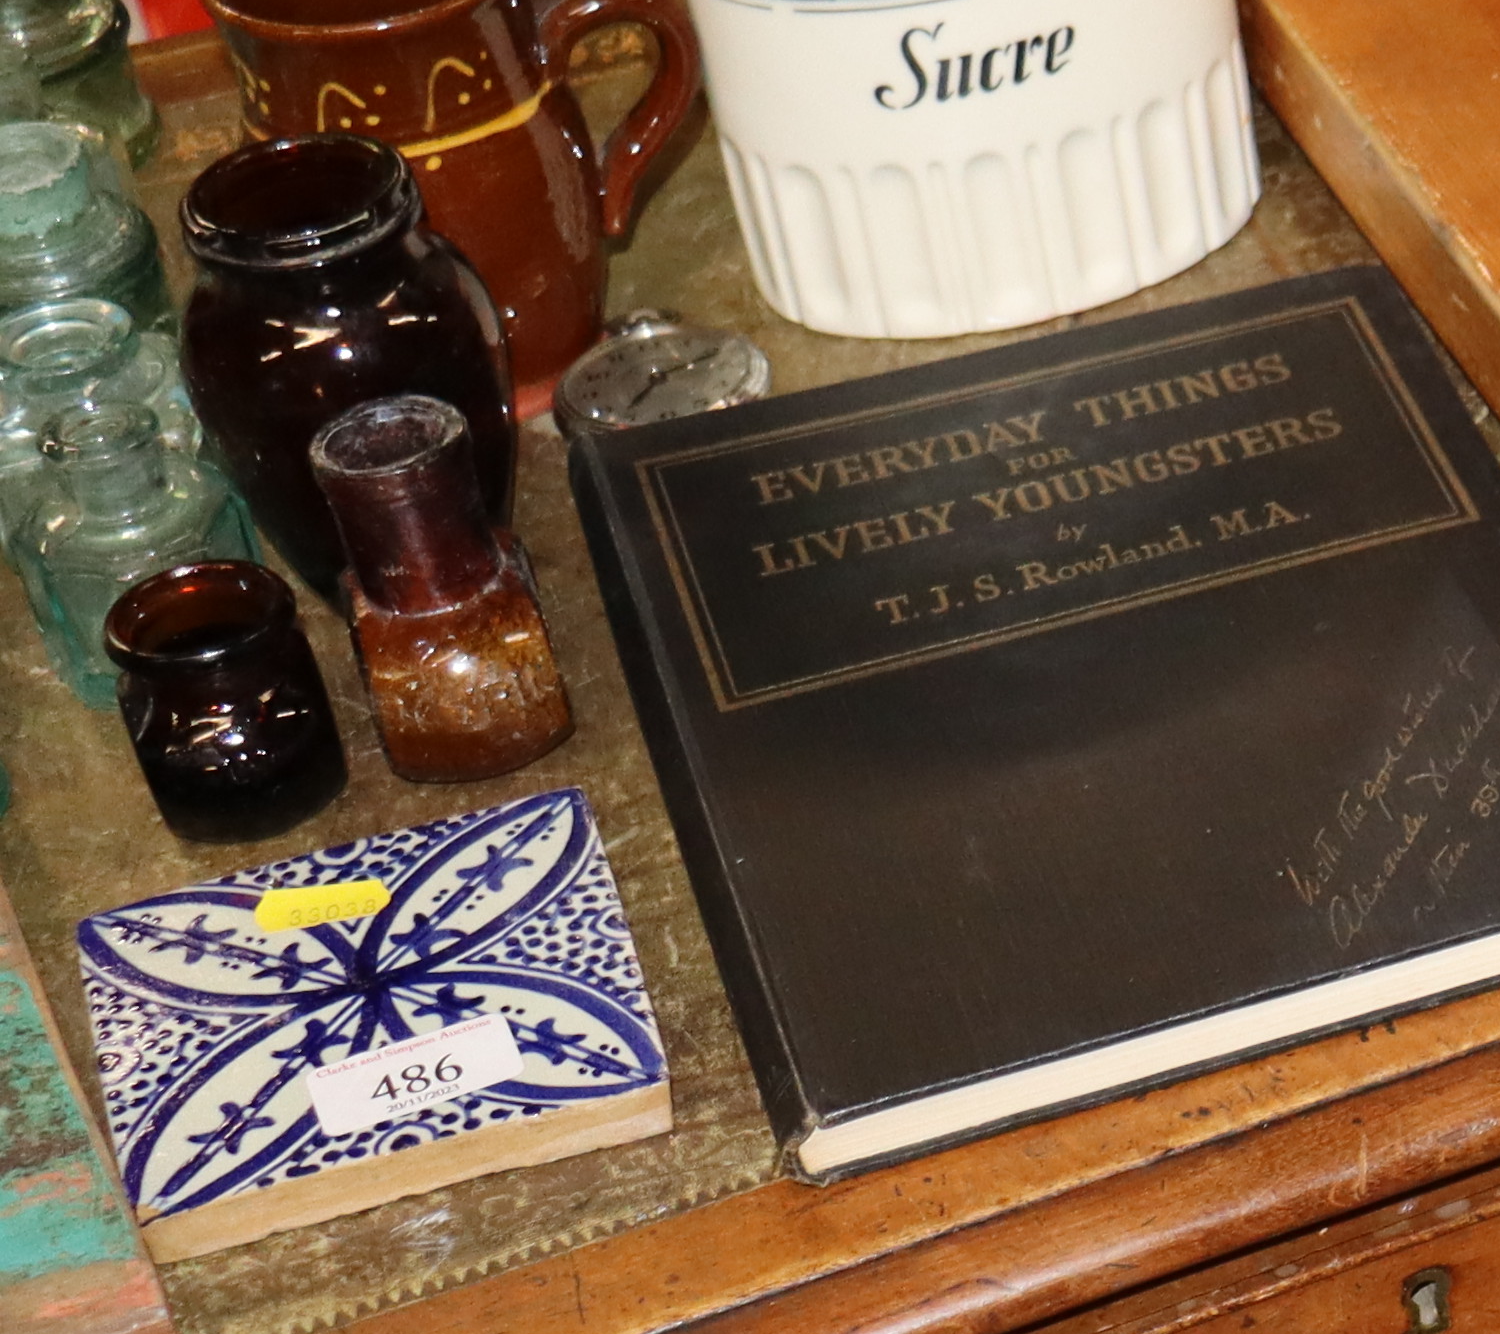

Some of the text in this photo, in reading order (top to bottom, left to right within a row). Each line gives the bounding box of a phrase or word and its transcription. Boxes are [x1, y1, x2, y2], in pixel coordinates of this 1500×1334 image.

[875, 20, 1076, 110] Sucre
[751, 352, 1293, 504] EVERYDAY THINGS
[1007, 446, 1078, 477] FOR
[752, 407, 1344, 578] LIVELY YOUNGSTERS
[1056, 521, 1088, 545] by
[289, 898, 378, 928] 33038
[316, 1019, 493, 1079] Clarke and Simpson Auctions
[371, 1053, 463, 1100] 486
[387, 1083, 460, 1113] 20/11/2023
